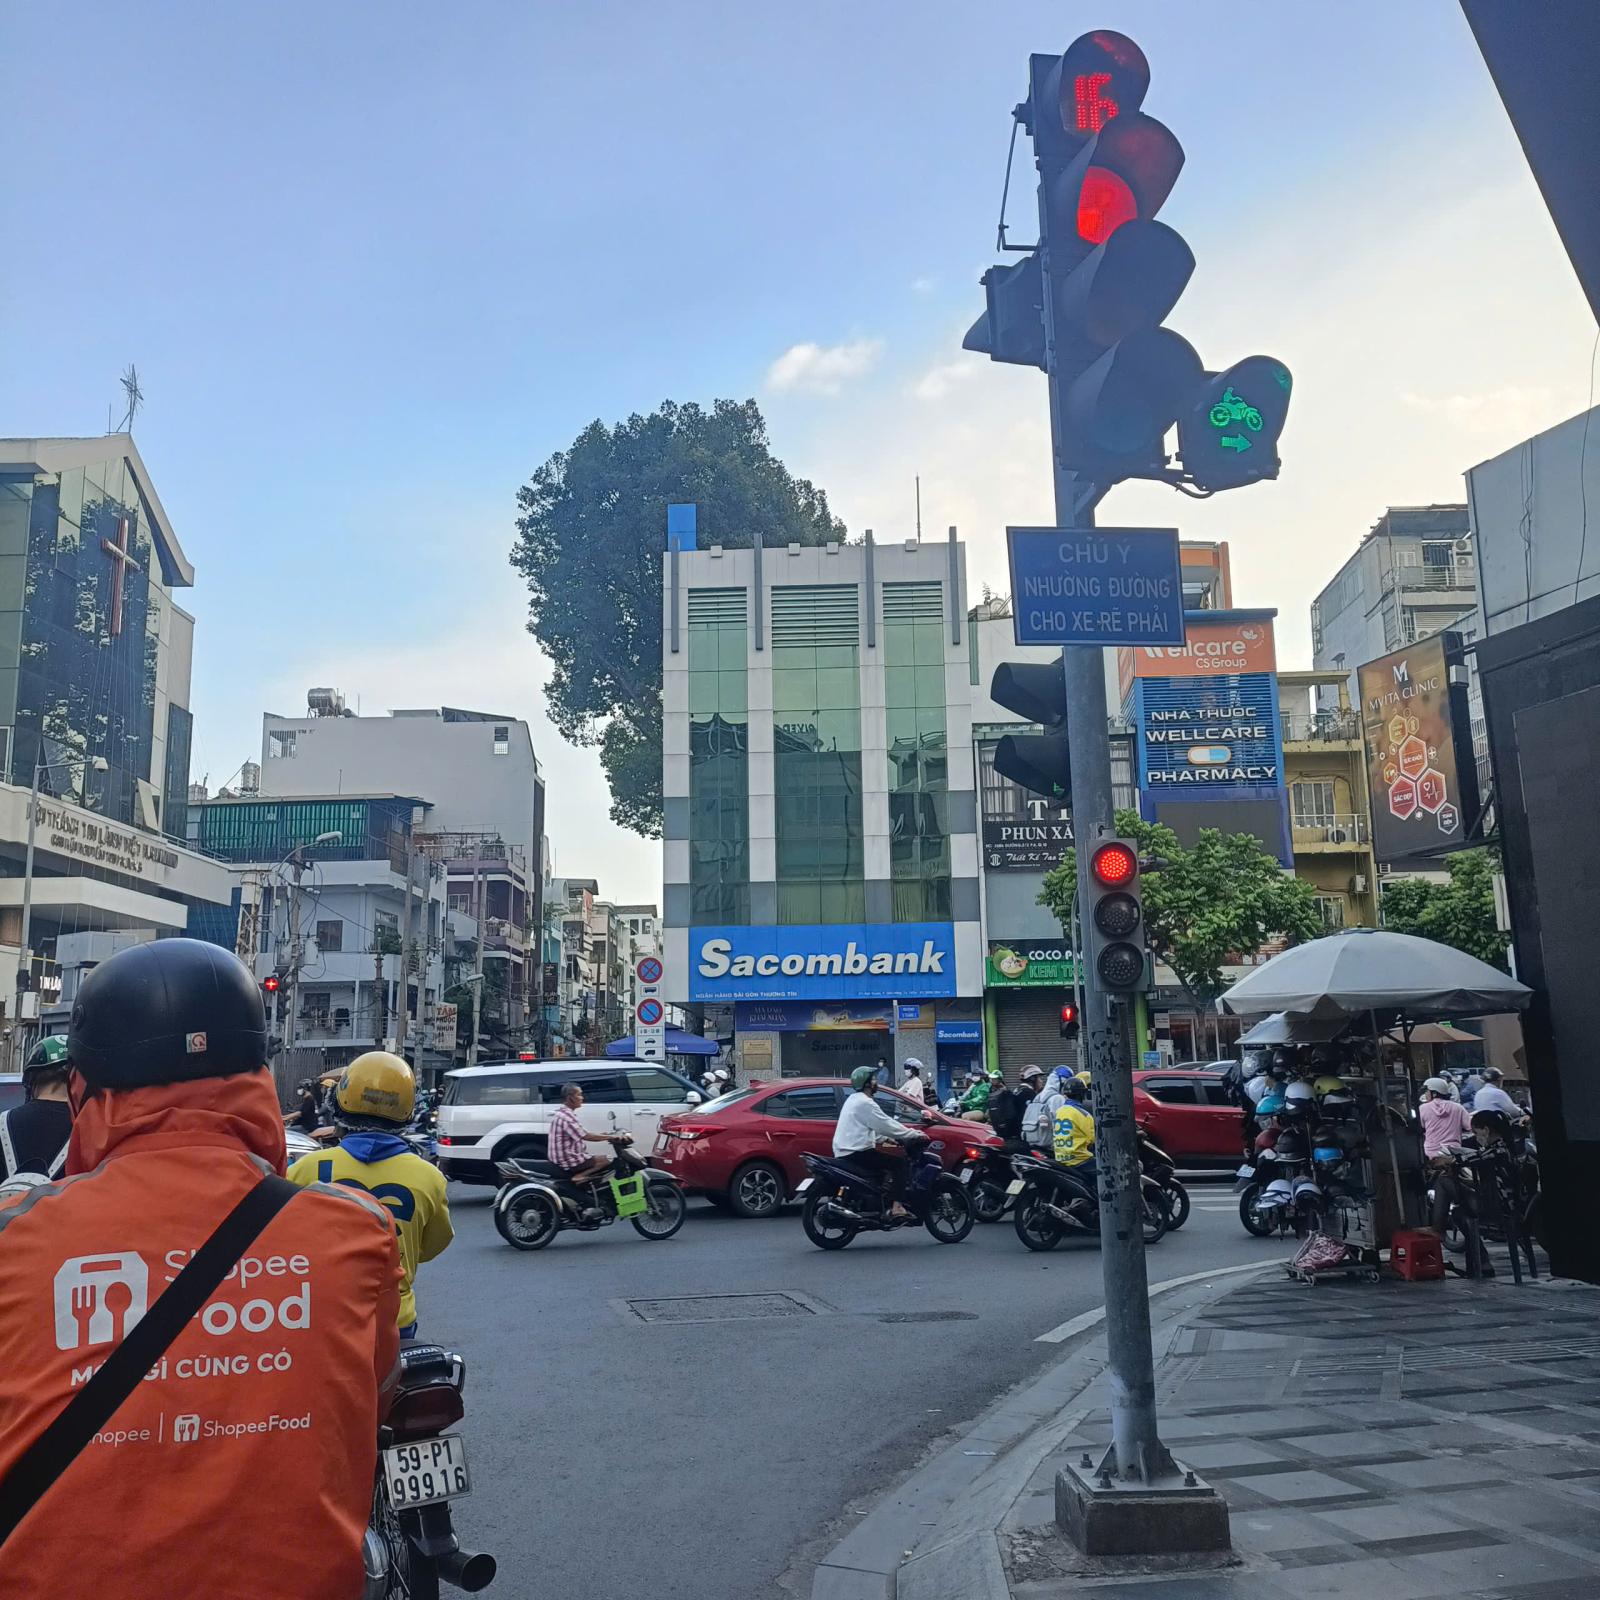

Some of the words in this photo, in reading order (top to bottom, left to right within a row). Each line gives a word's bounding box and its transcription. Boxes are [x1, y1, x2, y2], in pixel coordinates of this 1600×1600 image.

[1024, 569, 1100, 597] NHƯỜNG
[1108, 571, 1170, 599] ĐƯỜNG
[1030, 610, 1066, 632] CHO
[1072, 610, 1095, 632] XE
[1100, 607, 1122, 632] RẼ
[1128, 604, 1169, 633] PHẢI
[1196, 658, 1210, 669] CS
[1211, 657, 1247, 669] Group
[1369, 691, 1400, 711] MVITA
[1402, 677, 1439, 699] CLINIC
[1146, 726, 1267, 742] WELLCARE
[1147, 766, 1276, 783] PHARMACY
[1001, 826, 1048, 840] PHUN
[698, 938, 945, 978] Sacombank
[1028, 950, 1061, 960] COCO
[1029, 965, 1058, 978] KEM
[938, 1030, 979, 1038] Sacombank
[165, 1249, 310, 1289] Spee
[197, 1282, 311, 1335] ood
[176, 1354, 250, 1379] CŨNG
[257, 1347, 292, 1373] CÓ
[89, 1429, 151, 1448] hopee
[203, 1412, 311, 1440] ShopeeFood
[397, 1439, 453, 1473] 59-P1
[393, 1466, 466, 1504] 999.16
